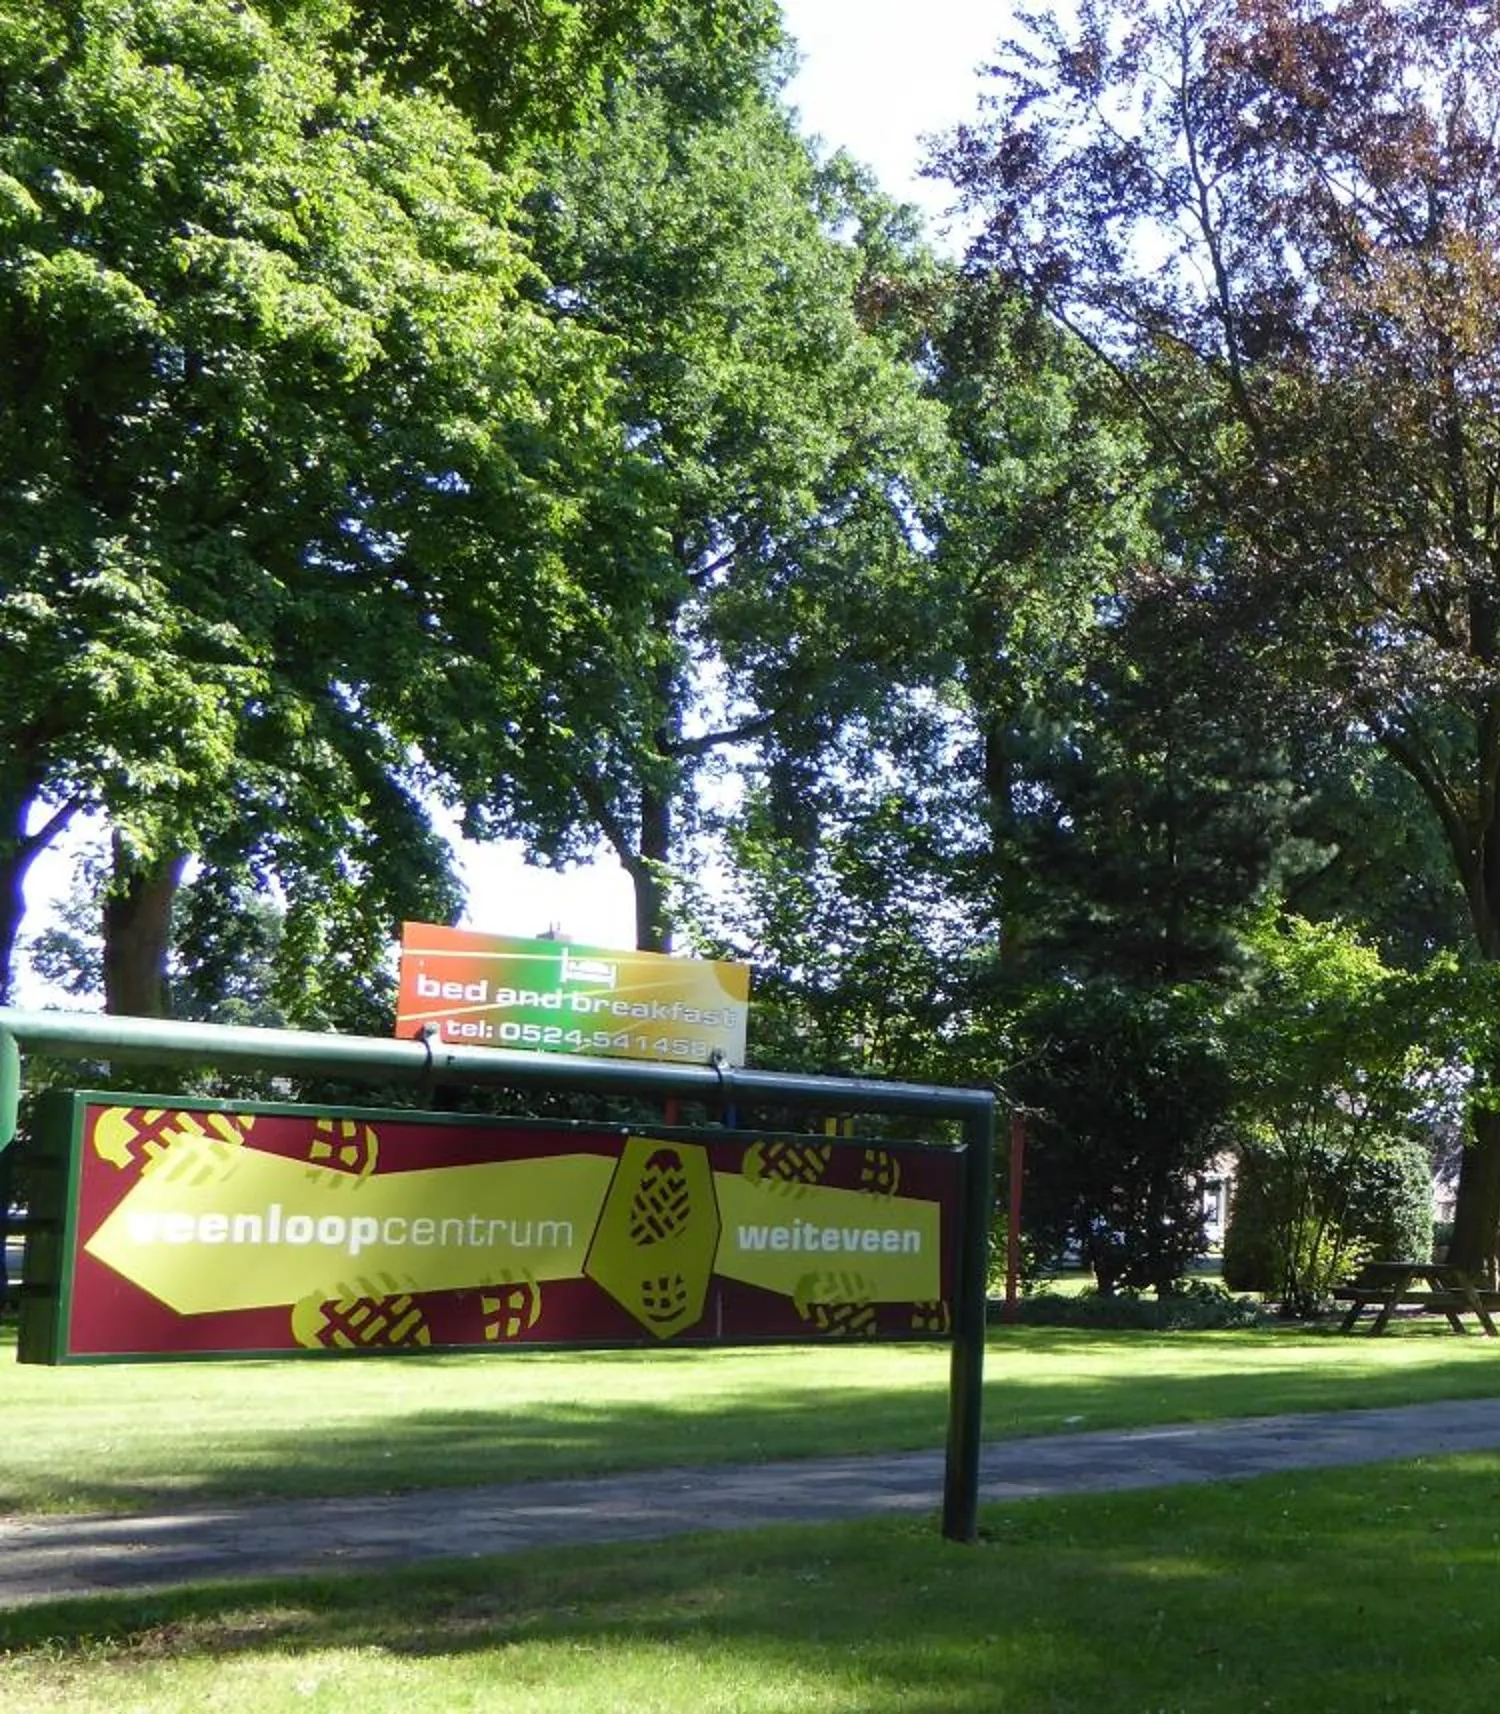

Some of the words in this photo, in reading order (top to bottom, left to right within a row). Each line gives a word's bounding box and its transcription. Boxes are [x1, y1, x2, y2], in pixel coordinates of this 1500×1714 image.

[416, 973, 489, 1002] bed
[495, 984, 562, 1009] and
[570, 988, 738, 1028] breakfast
[446, 1019, 494, 1039] tel:
[124, 1203, 573, 1255] veenloopcentrum
[737, 1218, 922, 1253] weiteveen
